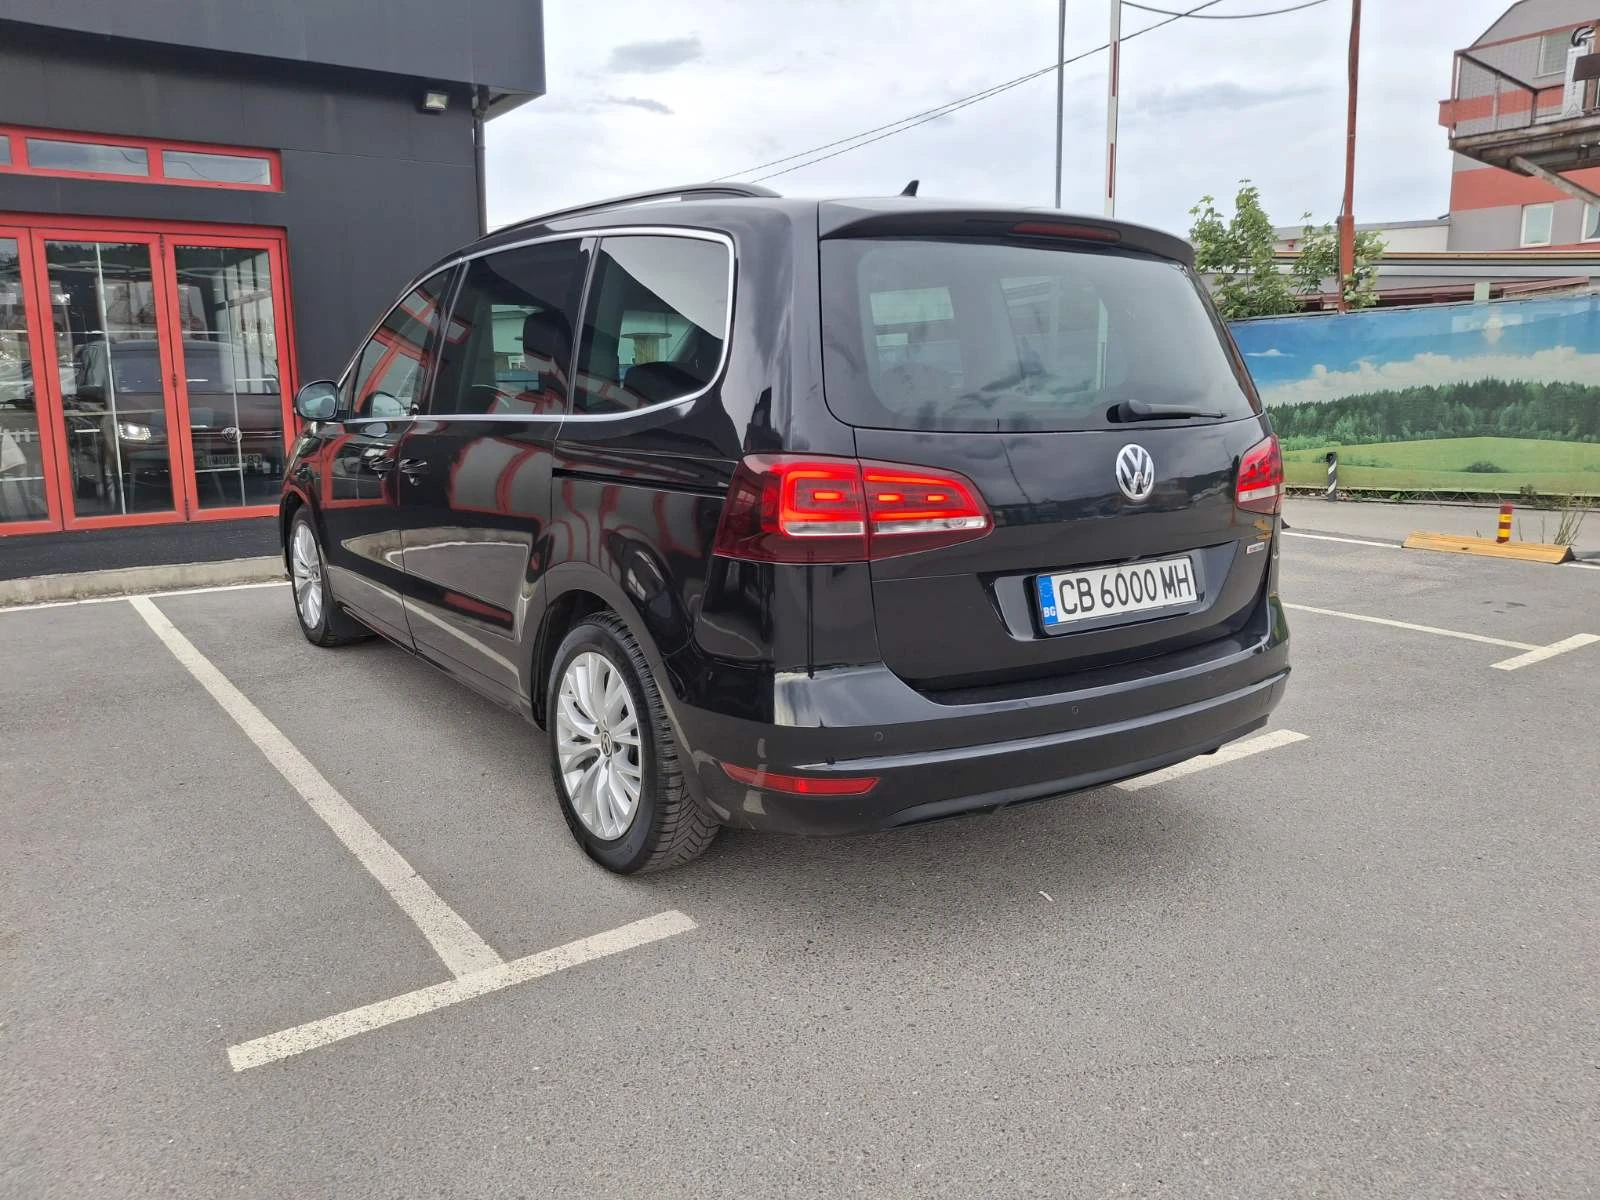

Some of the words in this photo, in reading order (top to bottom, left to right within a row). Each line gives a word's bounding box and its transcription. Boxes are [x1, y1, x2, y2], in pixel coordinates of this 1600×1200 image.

[1115, 443, 1155, 500] VW
[1043, 606, 1056, 617] BG
[1059, 578, 1095, 615] CB
[1100, 569, 1157, 609] 6000
[1160, 563, 1191, 599] MH
